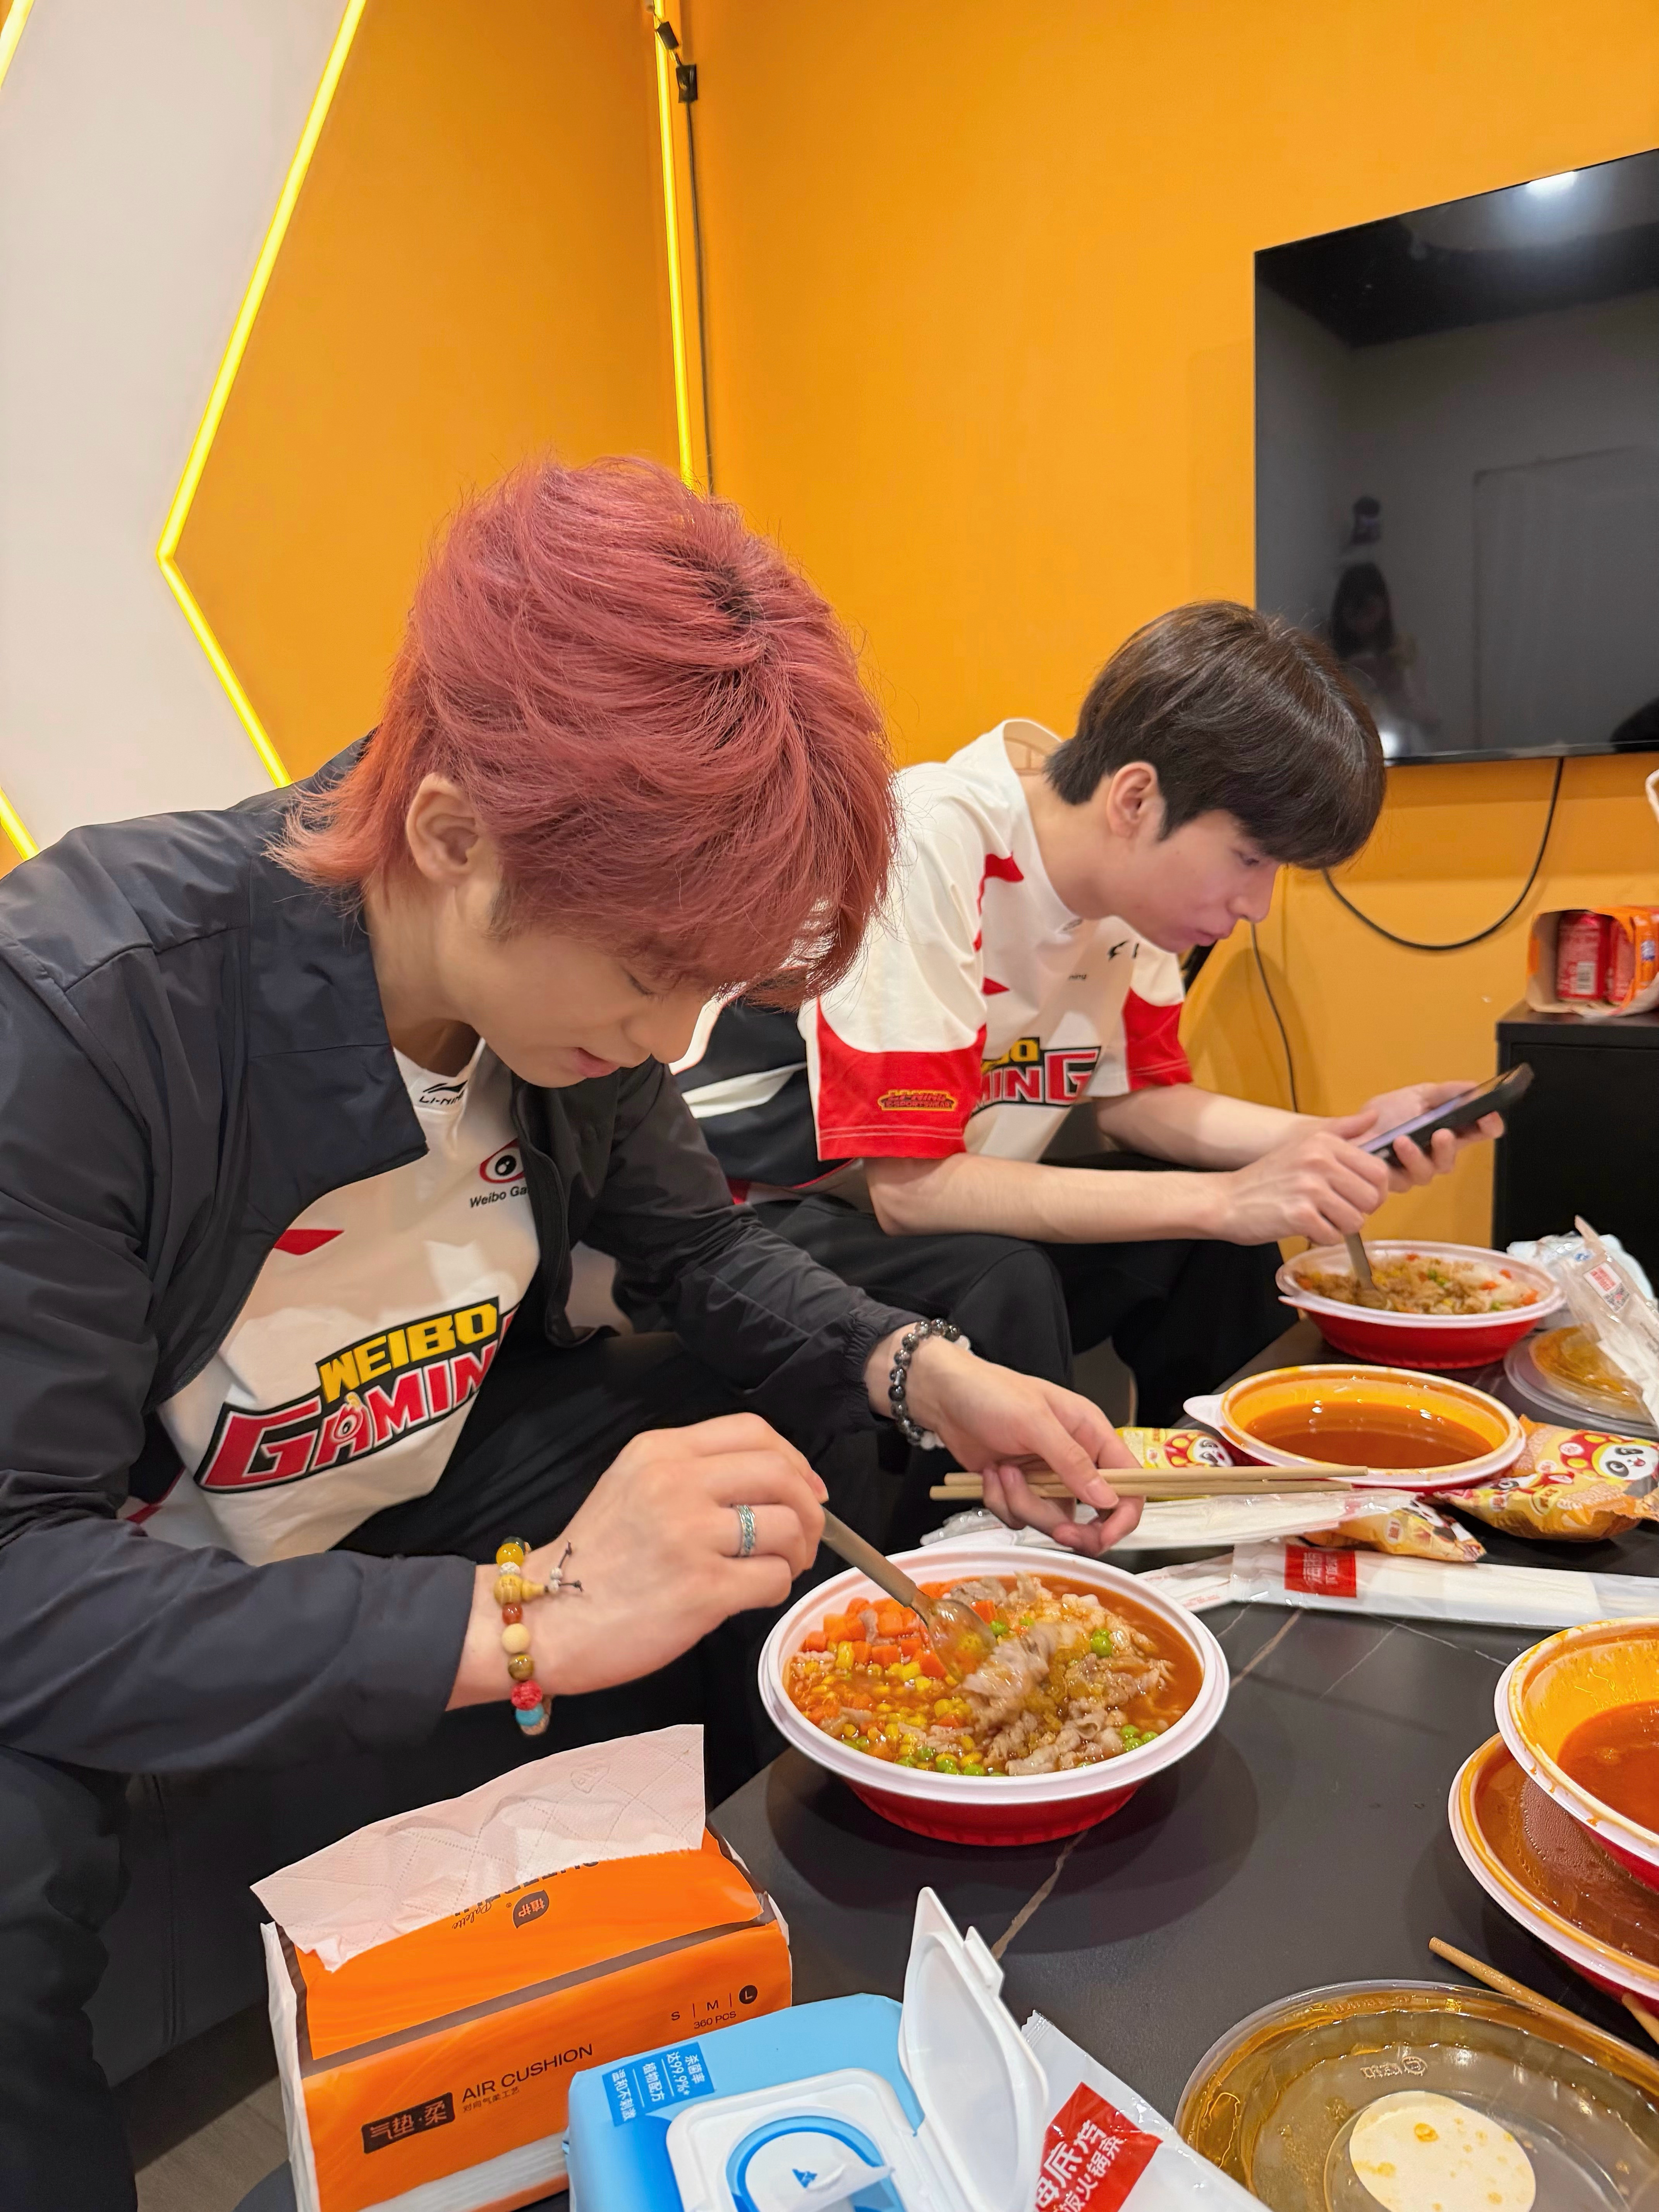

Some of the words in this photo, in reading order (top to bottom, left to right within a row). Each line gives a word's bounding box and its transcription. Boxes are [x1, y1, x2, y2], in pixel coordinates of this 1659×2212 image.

[470, 1192, 507, 1208] Weibo
[318, 1302, 500, 1404] WEIBO
[198, 1305, 520, 1489] GAMIN
[518, 1898, 545, 1917] 植护
[671, 2011, 680, 2021] S
[707, 2000, 719, 2011] M
[694, 2018, 713, 2029] 360
[462, 2080, 496, 2103] AIR
[501, 2044, 593, 2088] CUSHION
[642, 2062, 665, 2102] 植物配方
[685, 2054, 705, 2084] 杀菌率
